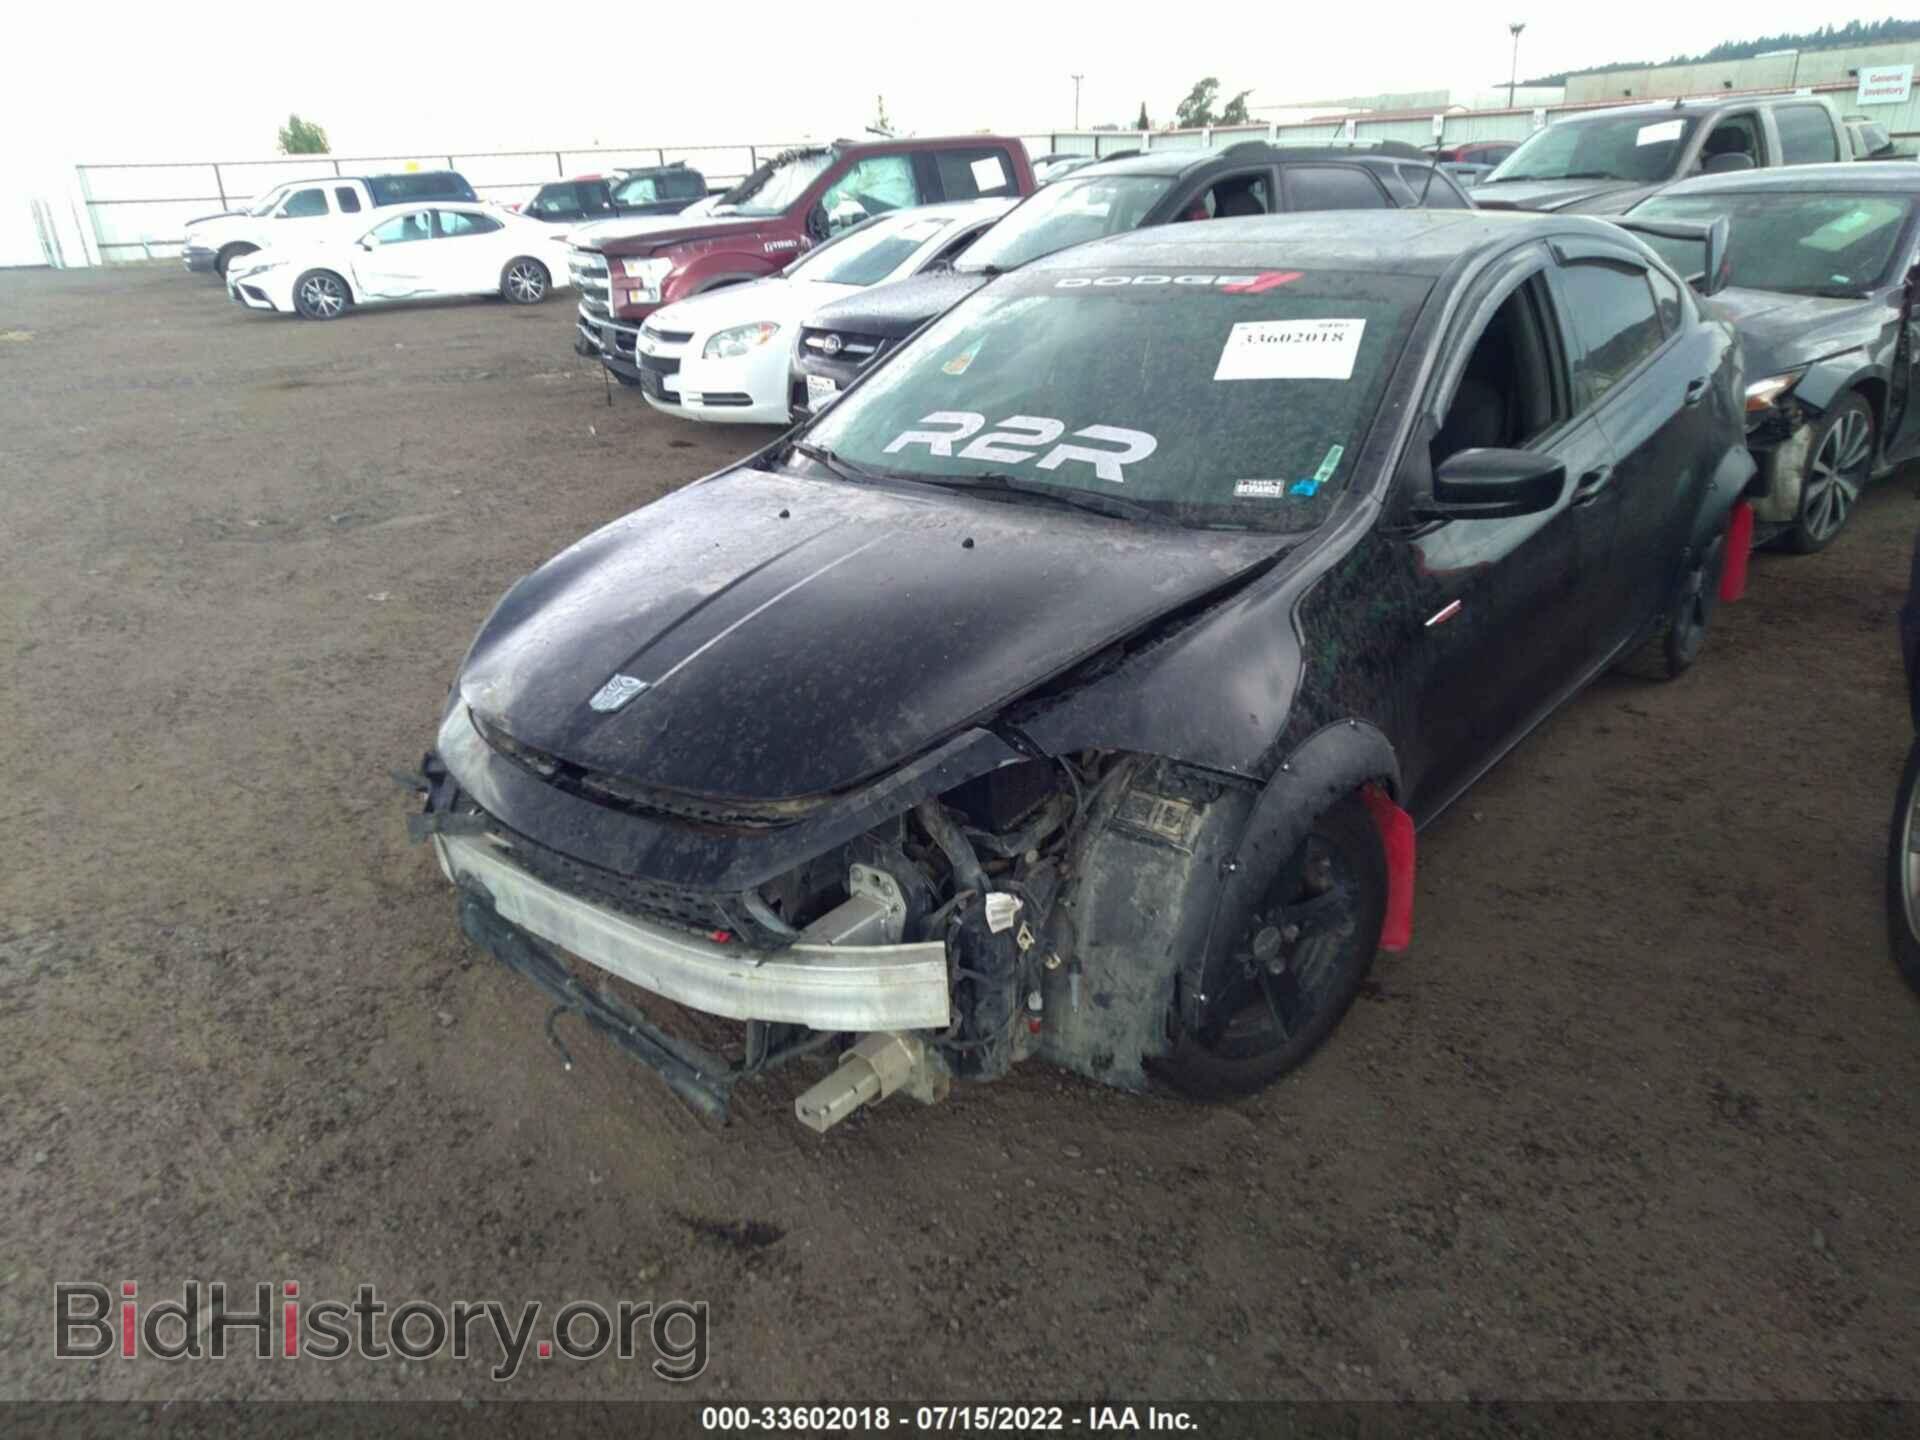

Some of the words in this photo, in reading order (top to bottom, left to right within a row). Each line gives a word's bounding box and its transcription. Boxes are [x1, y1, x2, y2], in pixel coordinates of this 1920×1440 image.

[1870, 72, 1904, 83] General
[1863, 87, 1905, 96] Inventory
[1055, 274, 1261, 288] DODGE
[882, 411, 1158, 483] R2R
